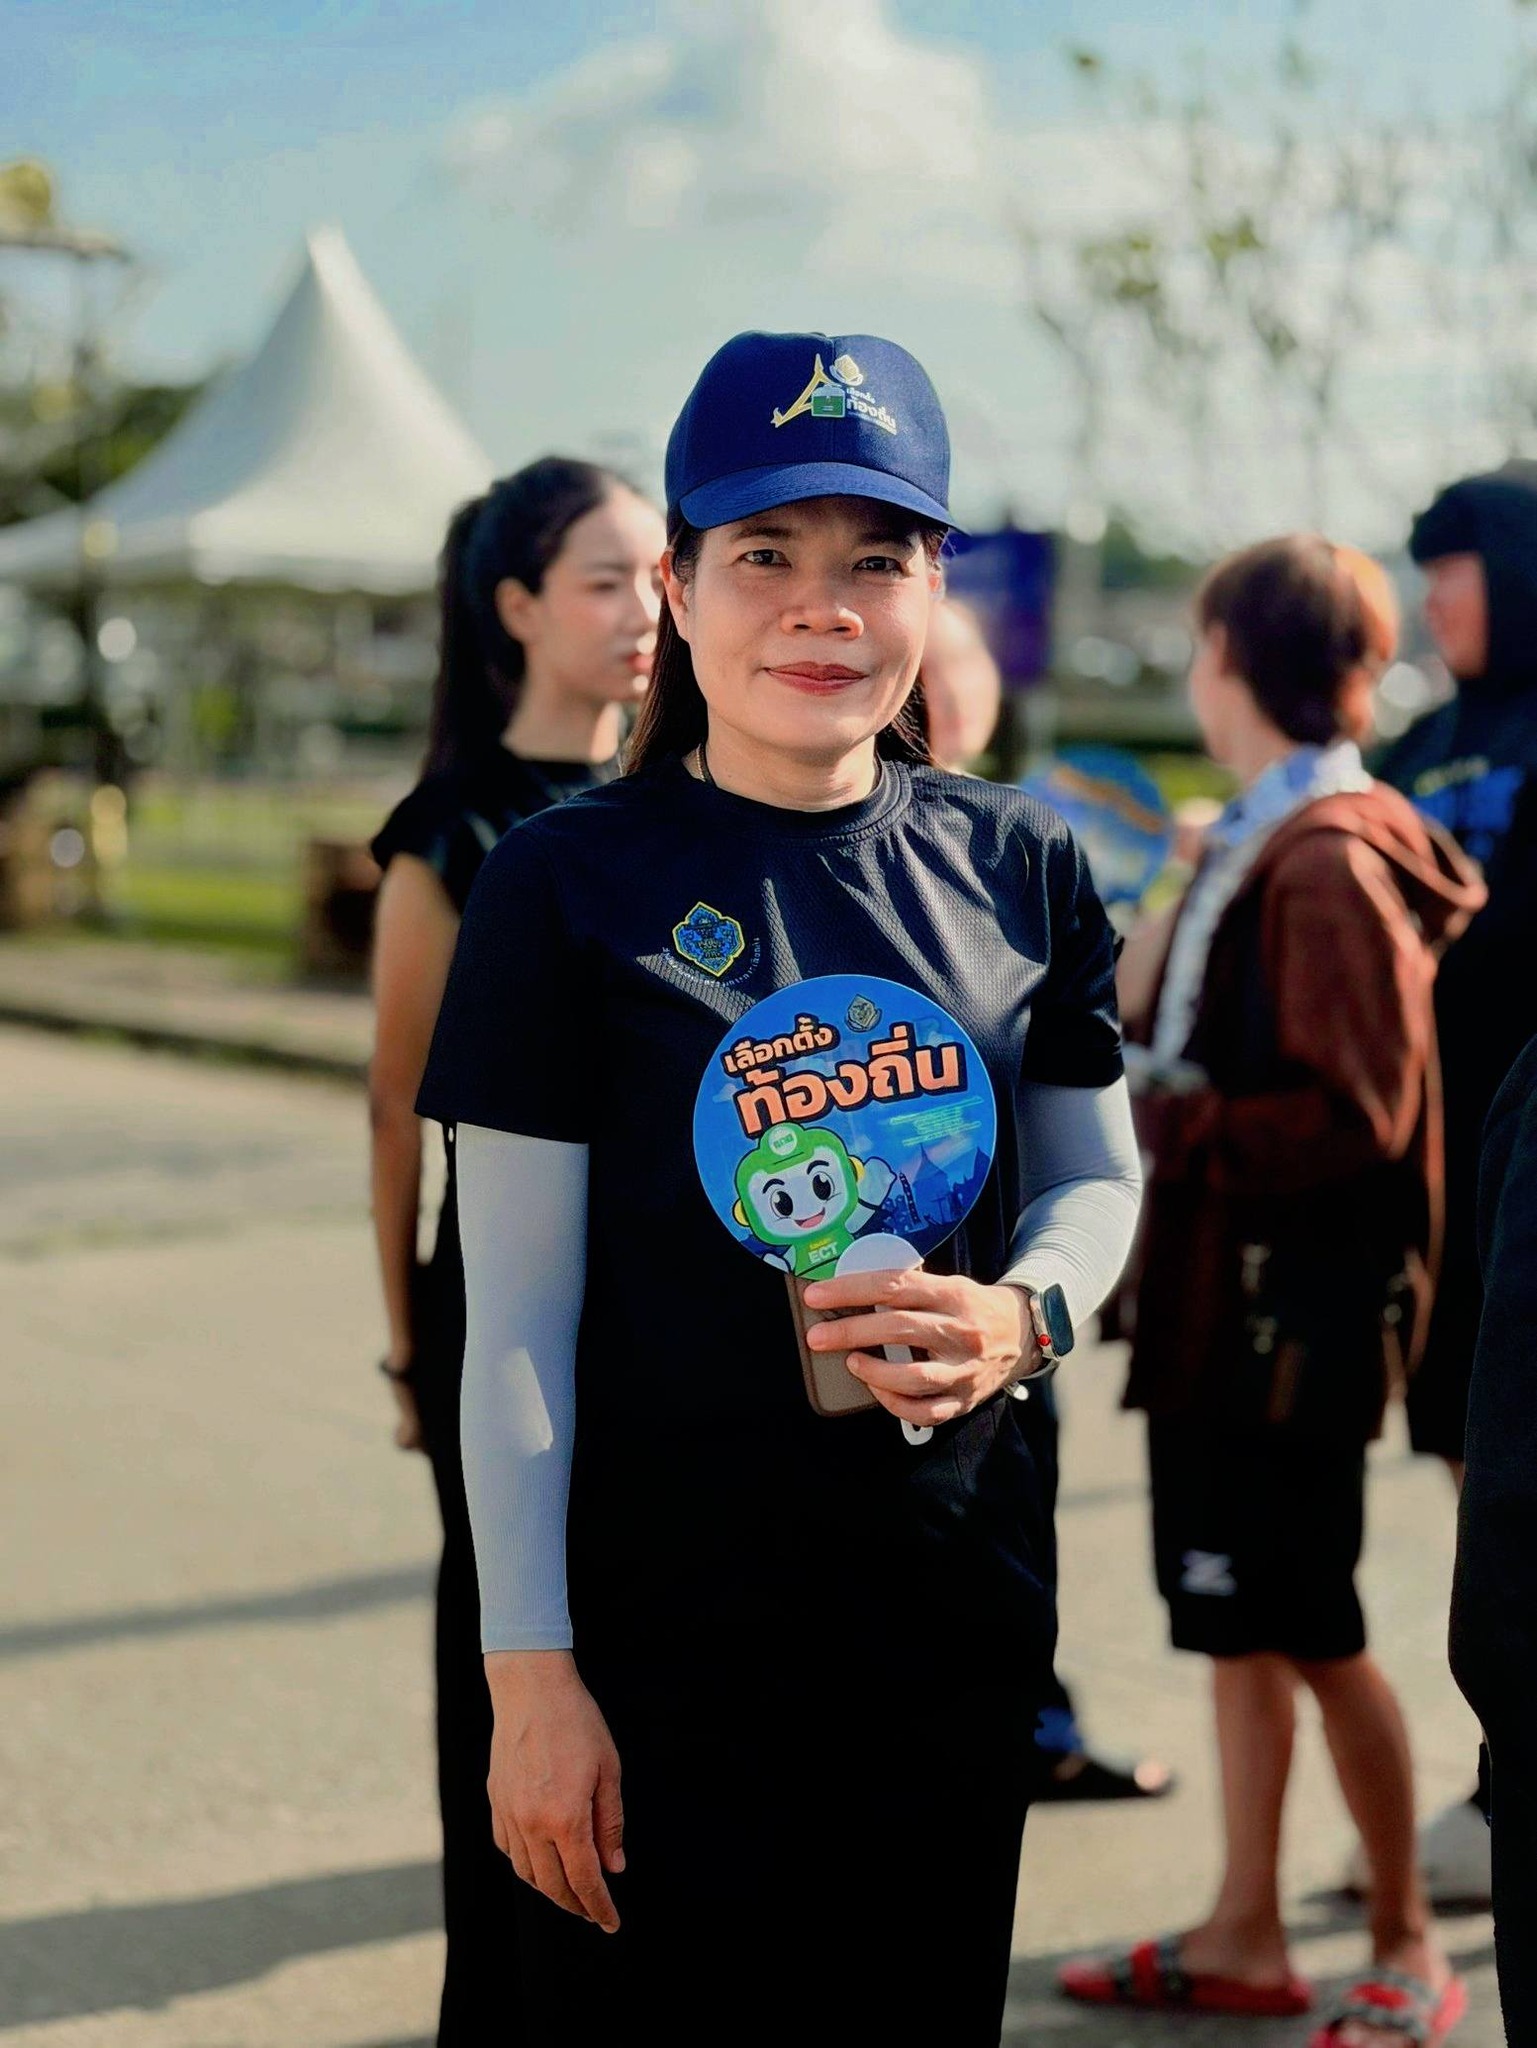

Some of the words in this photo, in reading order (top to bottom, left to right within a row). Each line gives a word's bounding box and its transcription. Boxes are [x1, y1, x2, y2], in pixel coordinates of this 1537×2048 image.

[723, 1016, 835, 1074] เลือกตั้ง
[736, 1025, 961, 1135] ท้องถิ่น
[808, 1242, 838, 1264] ECT
